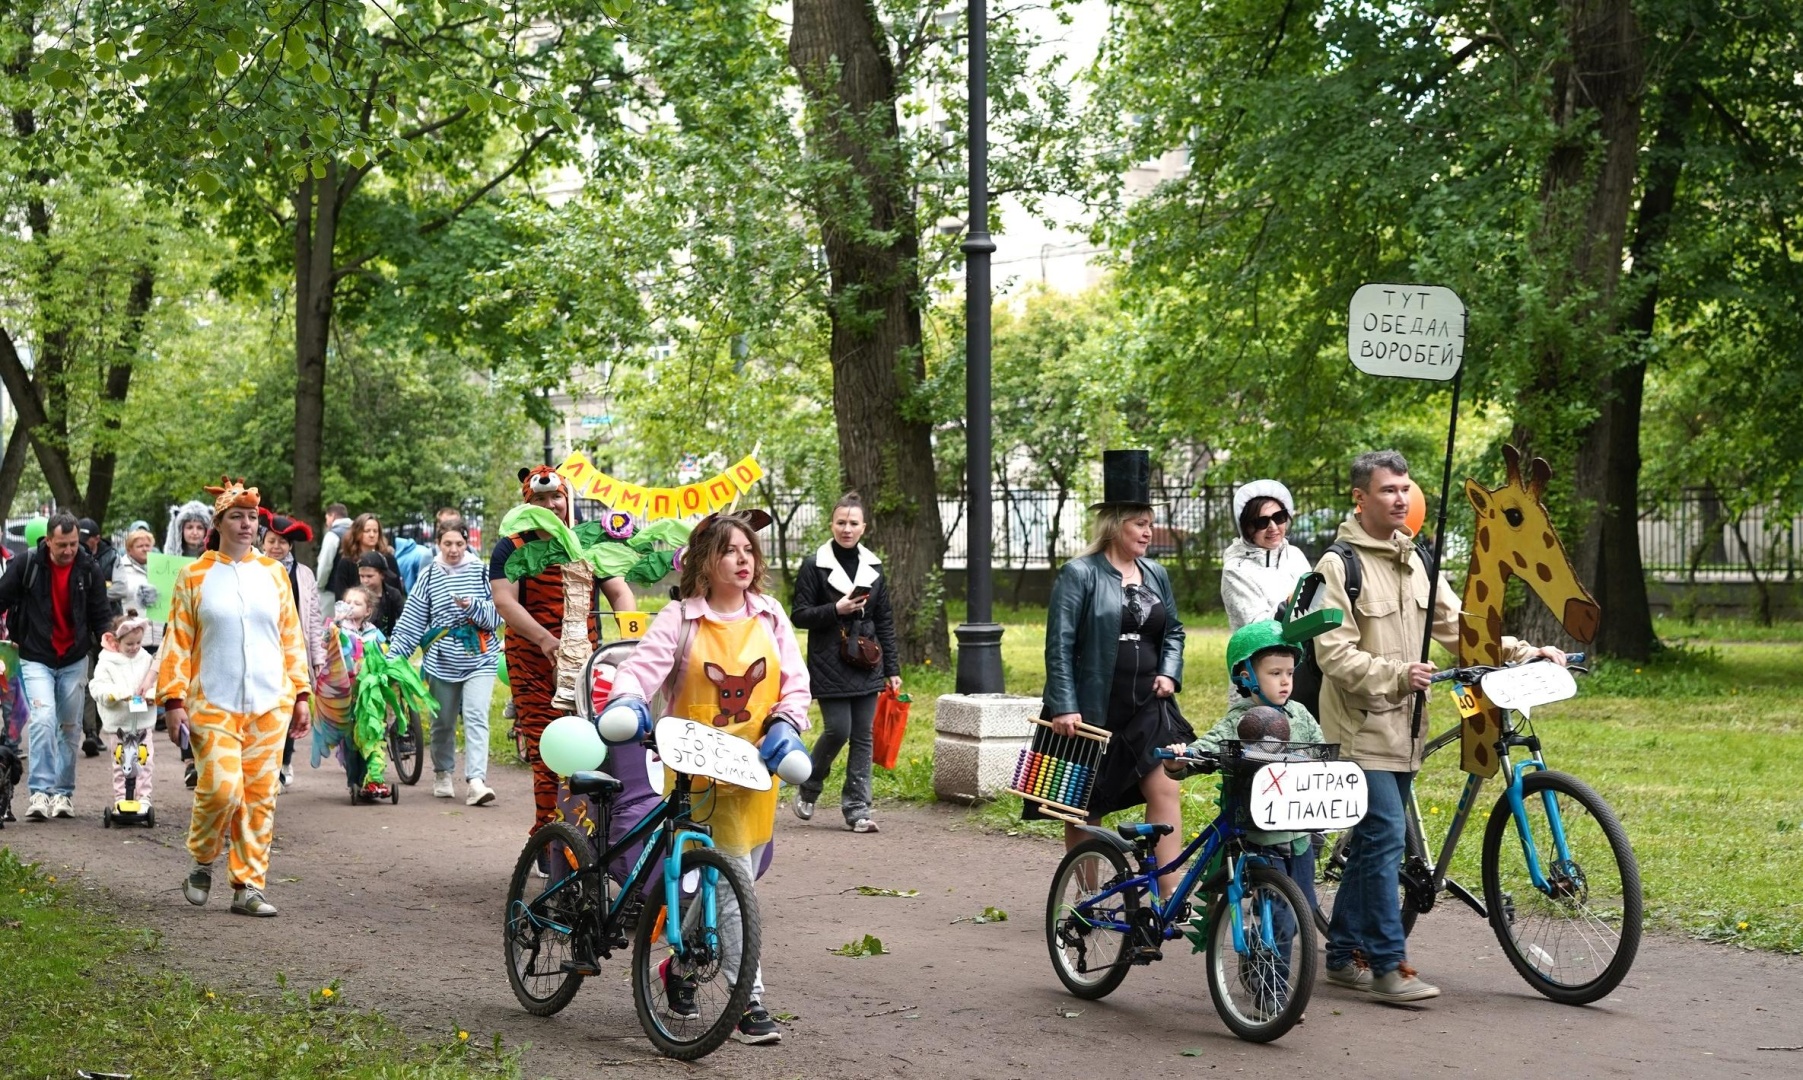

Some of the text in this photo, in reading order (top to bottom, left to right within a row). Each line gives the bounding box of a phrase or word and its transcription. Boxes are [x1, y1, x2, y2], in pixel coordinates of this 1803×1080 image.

[1383, 290, 1431, 310] ТУТ
[1363, 312, 1449, 338] ОБЕДАЛ
[1360, 340, 1454, 366] ВОРОБЕЙ
[566, 461, 754, 514] ЛИМПОПО
[628, 620, 639, 633] 8
[1458, 693, 1475, 711] 40
[684, 721, 696, 736] Я
[673, 747, 706, 768] ЭТО
[1296, 773, 1359, 792] ШТРАФ
[1264, 799, 1360, 825] 1 ПАЛЕЦ
[631, 833, 656, 881] STERN
